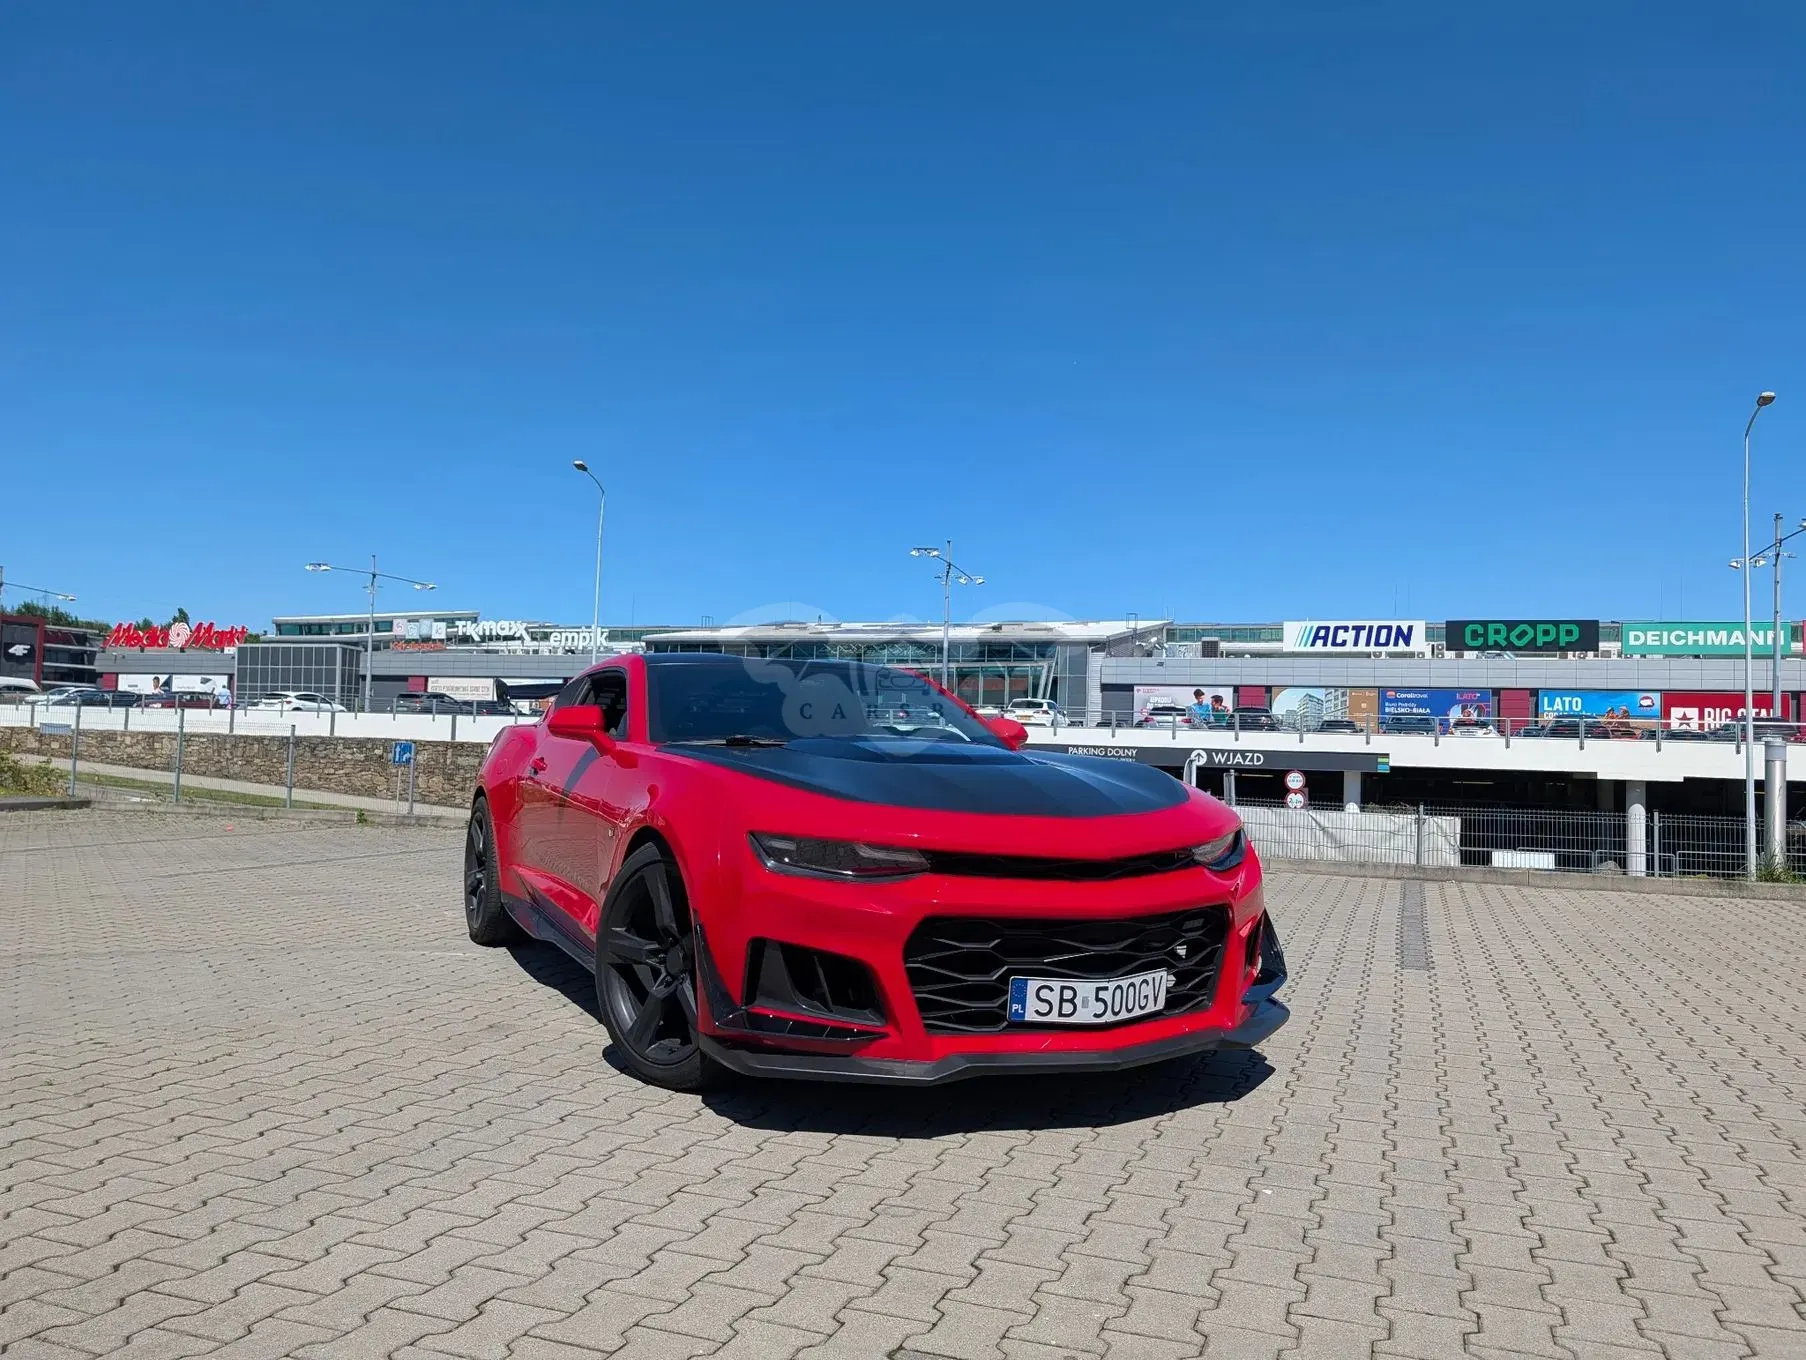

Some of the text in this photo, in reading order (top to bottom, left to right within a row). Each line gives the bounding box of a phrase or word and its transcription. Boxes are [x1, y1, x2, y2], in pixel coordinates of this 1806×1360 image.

[181, 621, 248, 648] Markt
[550, 625, 609, 650] empik
[1309, 624, 1414, 647] ACTION
[1464, 624, 1580, 647] CROPP
[1628, 630, 1785, 646] DEICHMANN
[8, 644, 31, 656] 4F
[1543, 697, 1582, 711] LATO
[1068, 746, 1138, 757] PARKING DOLNY
[1211, 751, 1264, 766] WJAZD
[1033, 975, 1164, 1019] SB 500GV
[1011, 1004, 1024, 1013] PL
